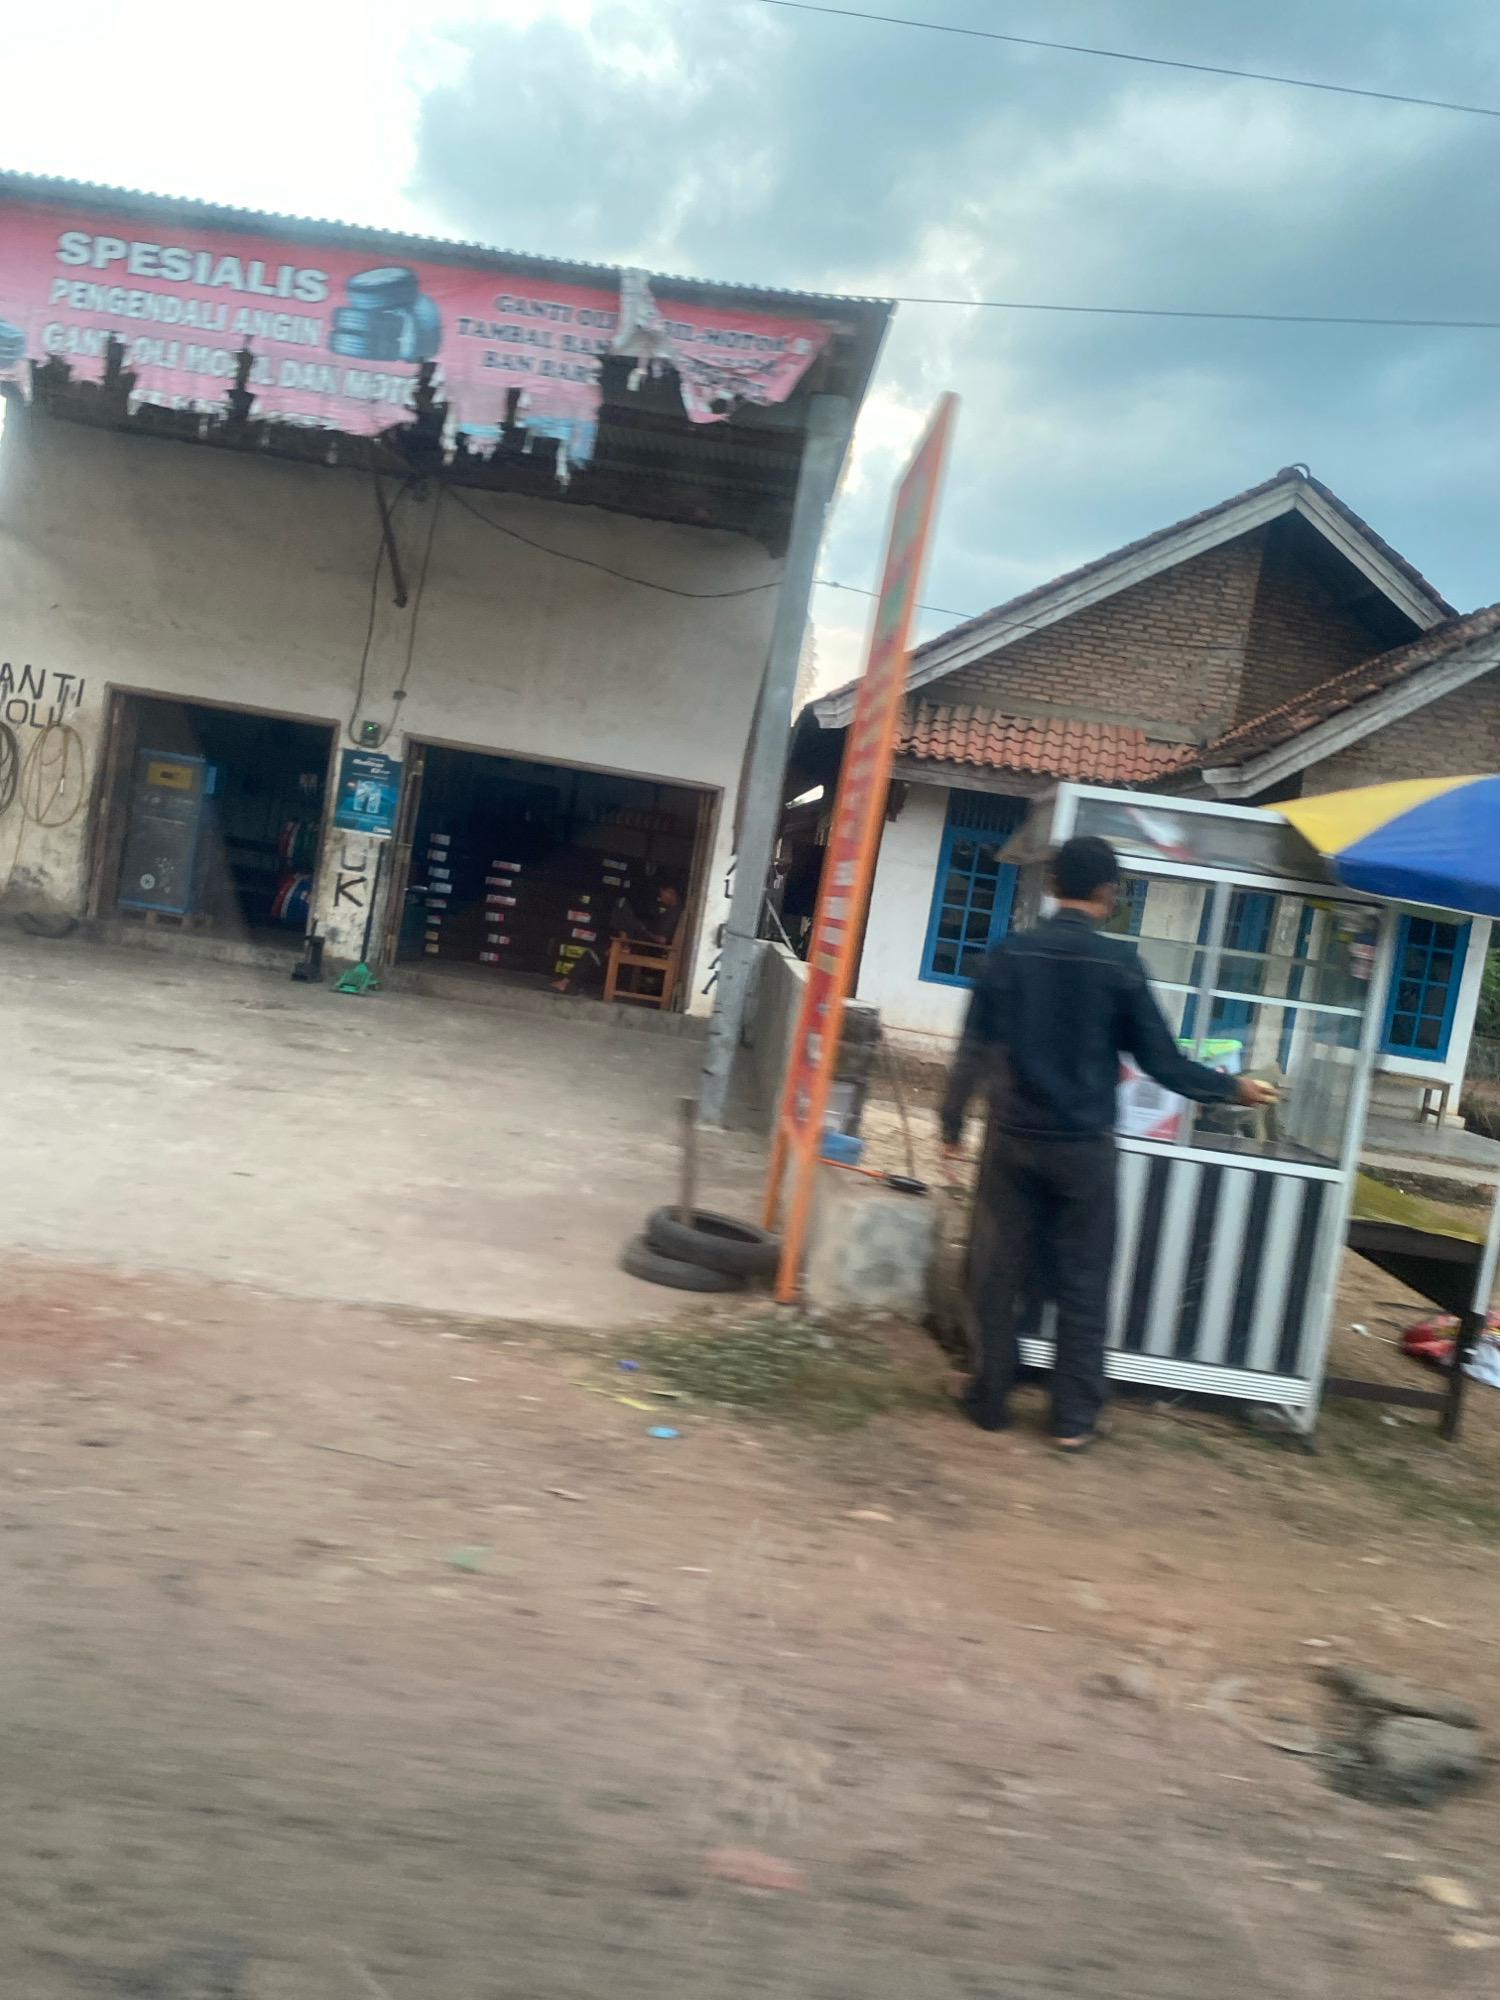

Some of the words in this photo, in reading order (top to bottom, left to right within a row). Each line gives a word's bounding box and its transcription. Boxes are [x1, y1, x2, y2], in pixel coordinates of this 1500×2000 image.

[57, 230, 330, 303] SPESIALIS
[49, 277, 229, 332] PENGENDALI
[230, 306, 324, 347] ANGIN
[494, 293, 574, 324] GANTI
[575, 308, 619, 330] OLI
[456, 316, 556, 349] TAMBAL
[279, 358, 339, 394] DAN
[481, 350, 536, 374] BAN
